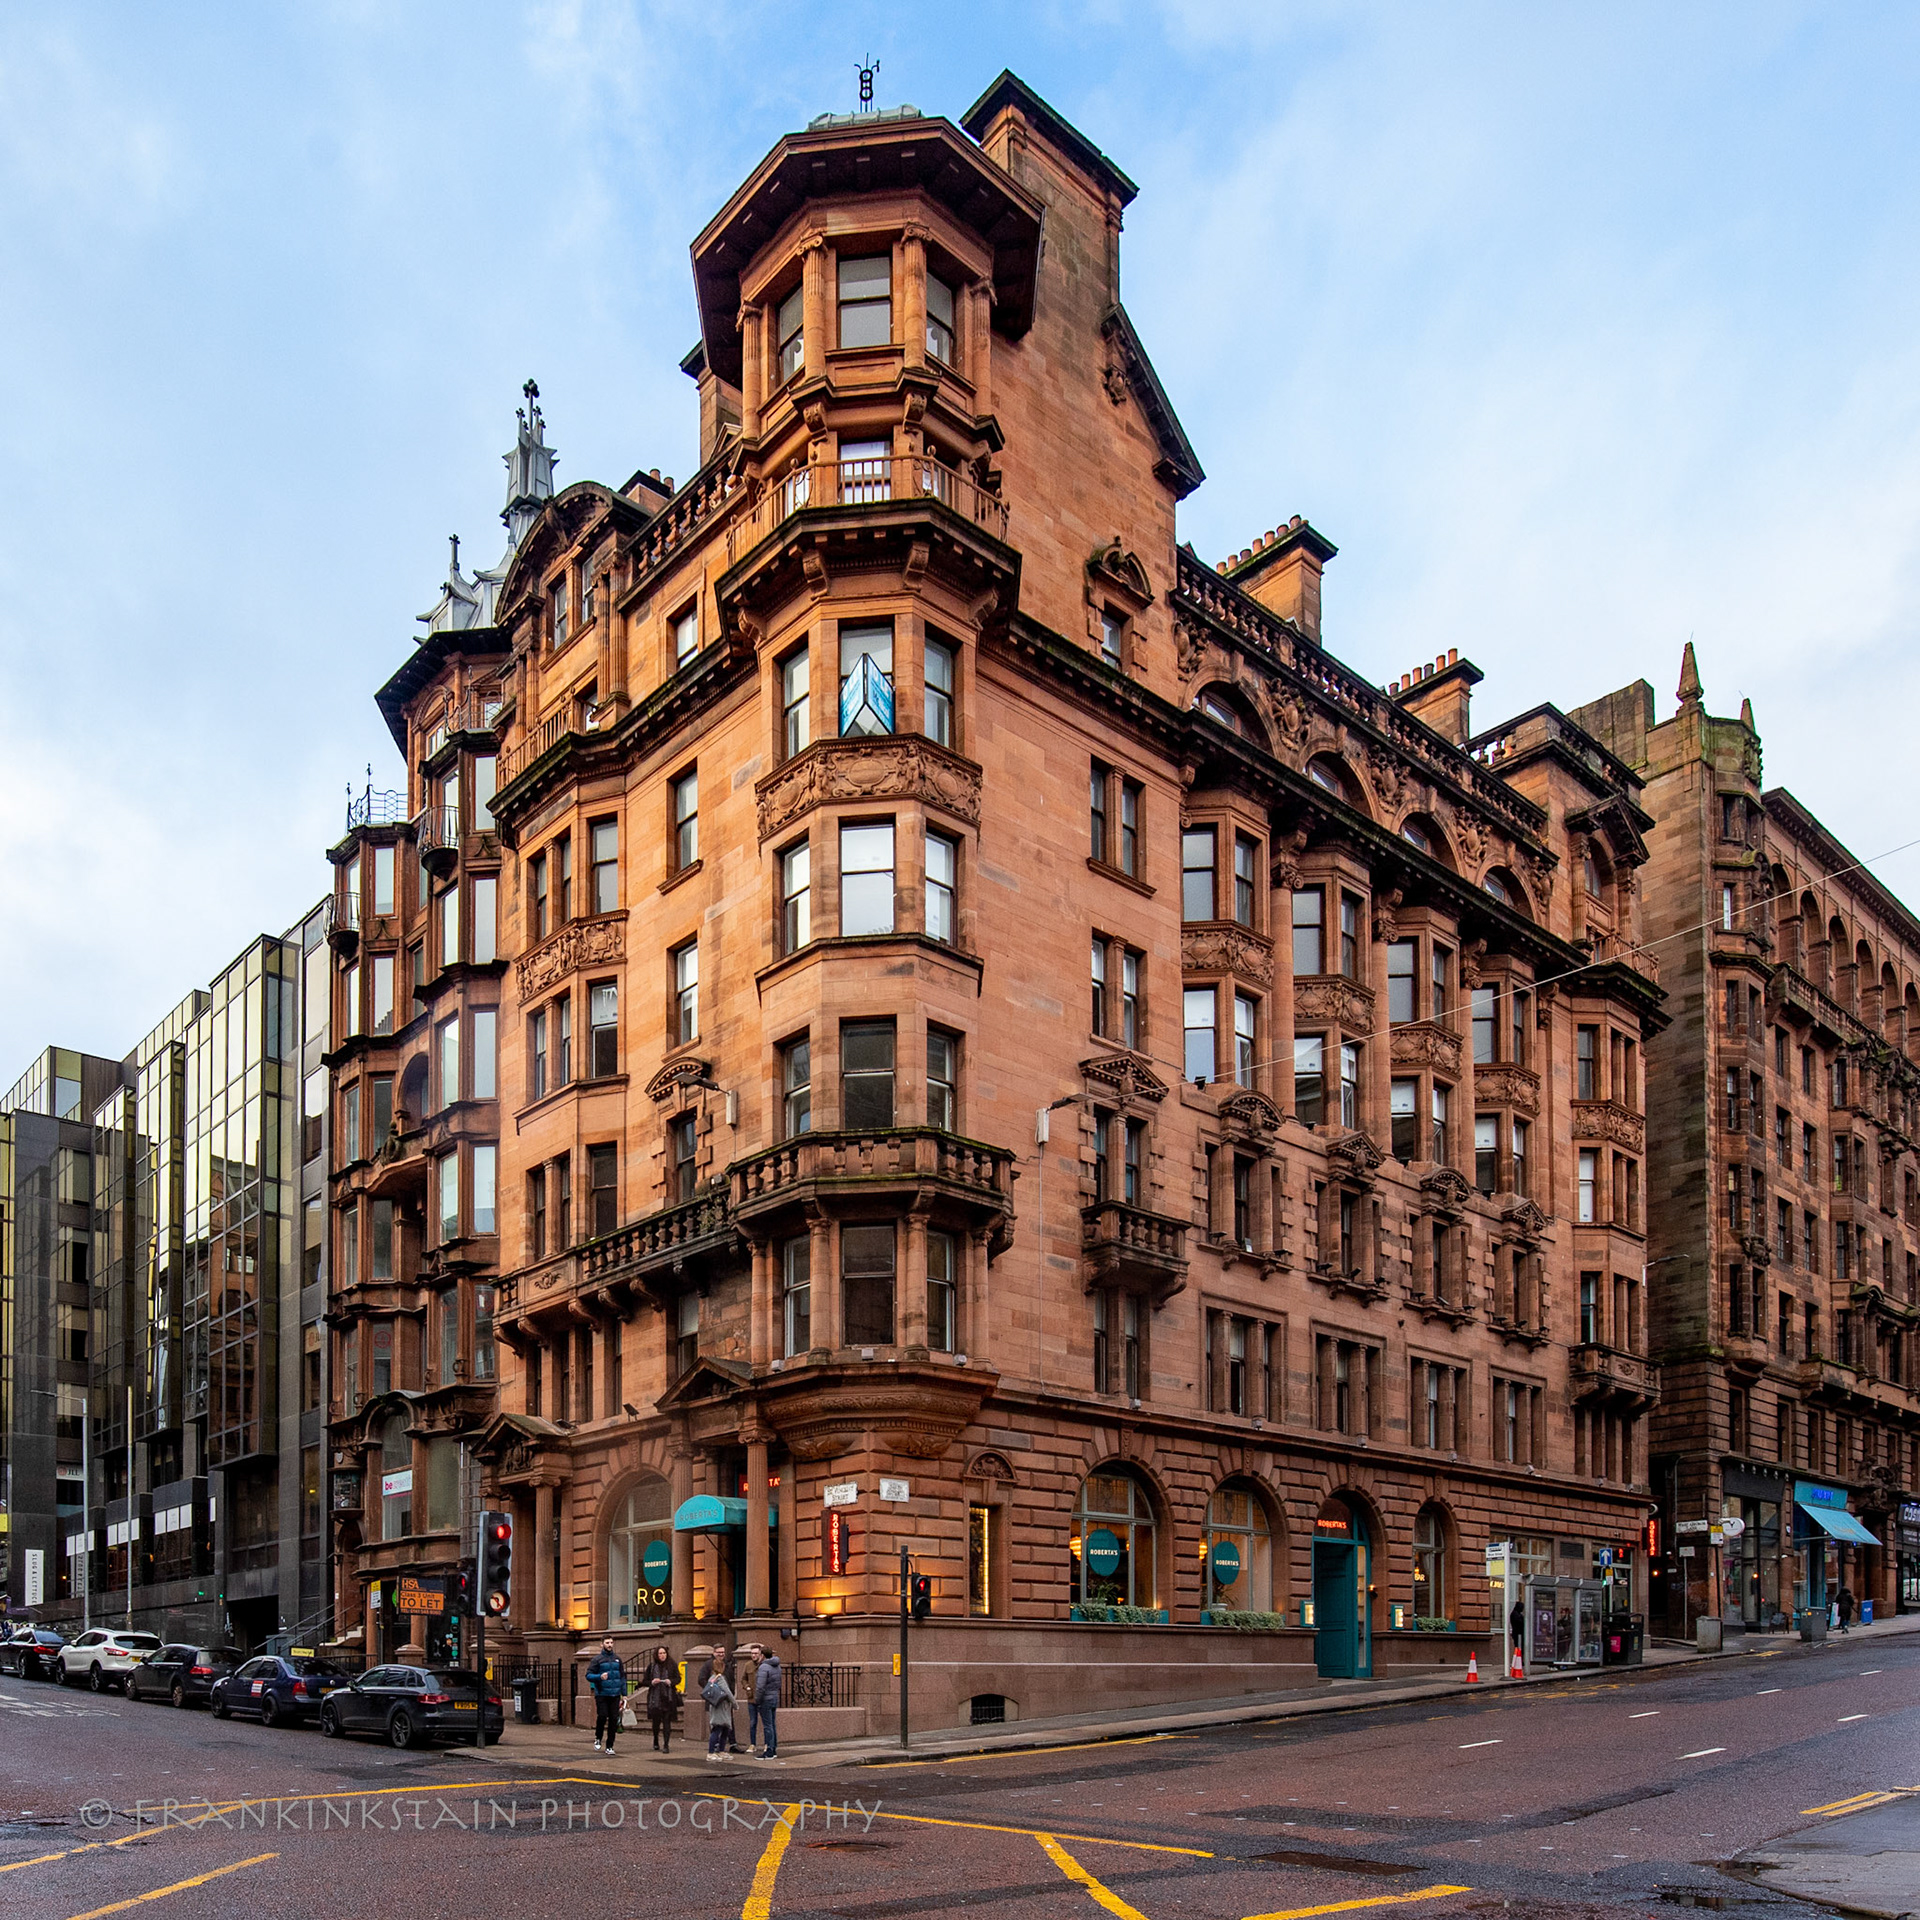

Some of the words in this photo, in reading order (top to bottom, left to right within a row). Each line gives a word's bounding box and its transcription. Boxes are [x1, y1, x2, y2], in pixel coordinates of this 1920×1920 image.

[680, 1509, 718, 1521] ROBERTA'S
[1318, 1520, 1347, 1529] ROBERTA'S
[402, 1578, 420, 1590] HSA
[401, 1598, 416, 1607] TO
[420, 1599, 440, 1608] LET
[637, 1588, 672, 1606] RO
